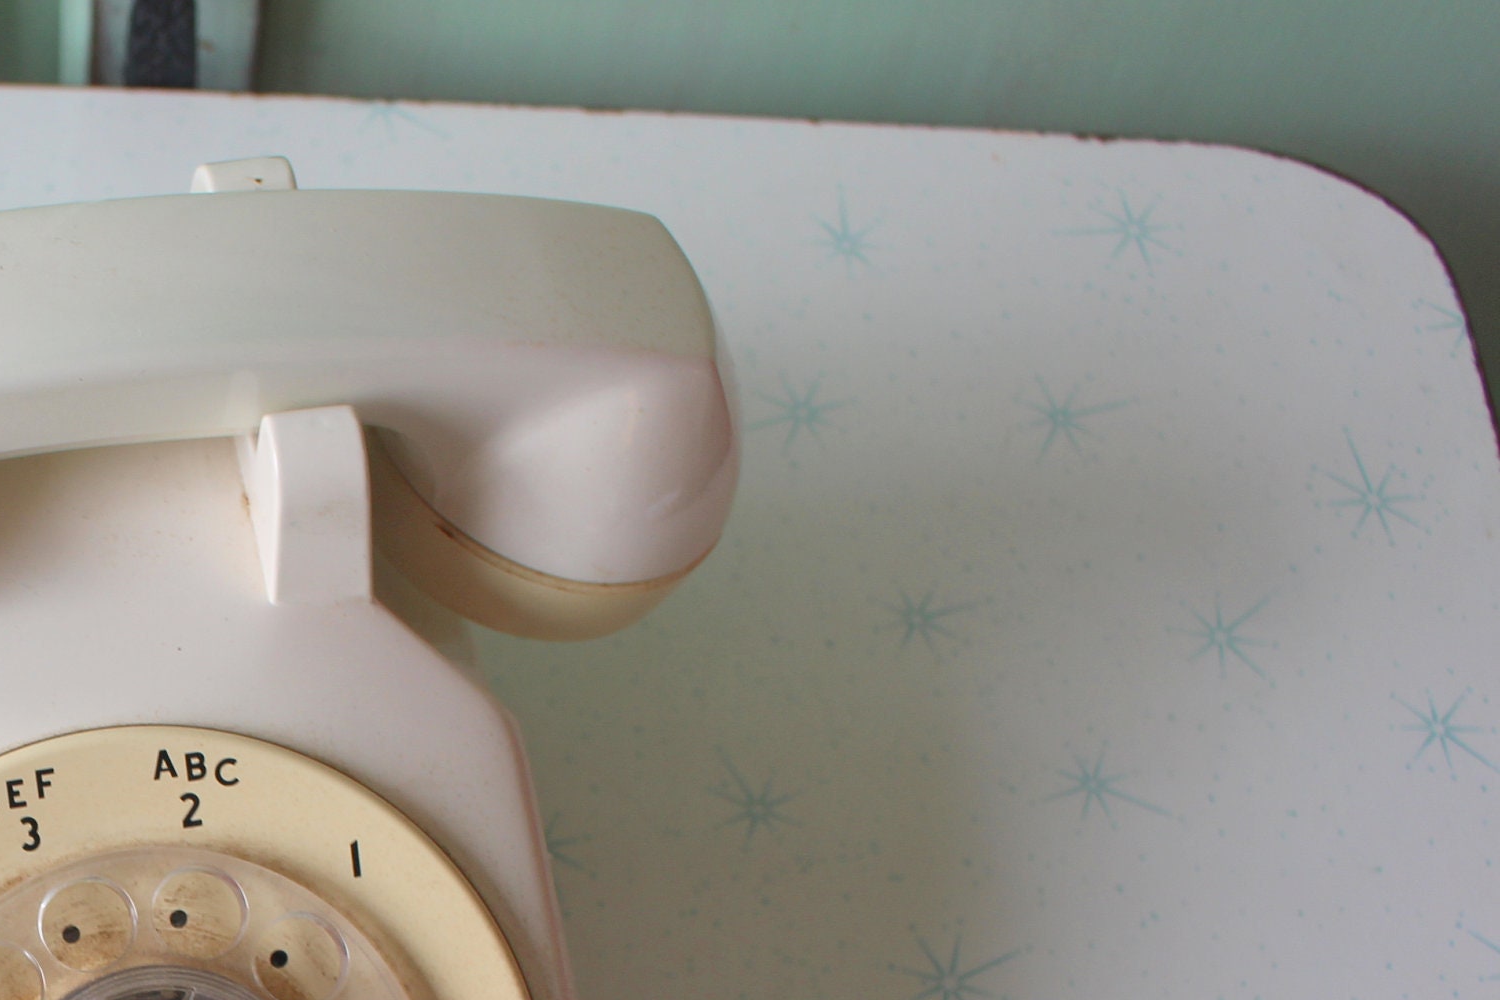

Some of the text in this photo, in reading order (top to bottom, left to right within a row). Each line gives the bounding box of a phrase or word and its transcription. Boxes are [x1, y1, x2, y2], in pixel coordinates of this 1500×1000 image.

[153, 749, 240, 788] ABC
[180, 792, 204, 829] 2
[21, 816, 42, 852] 3
